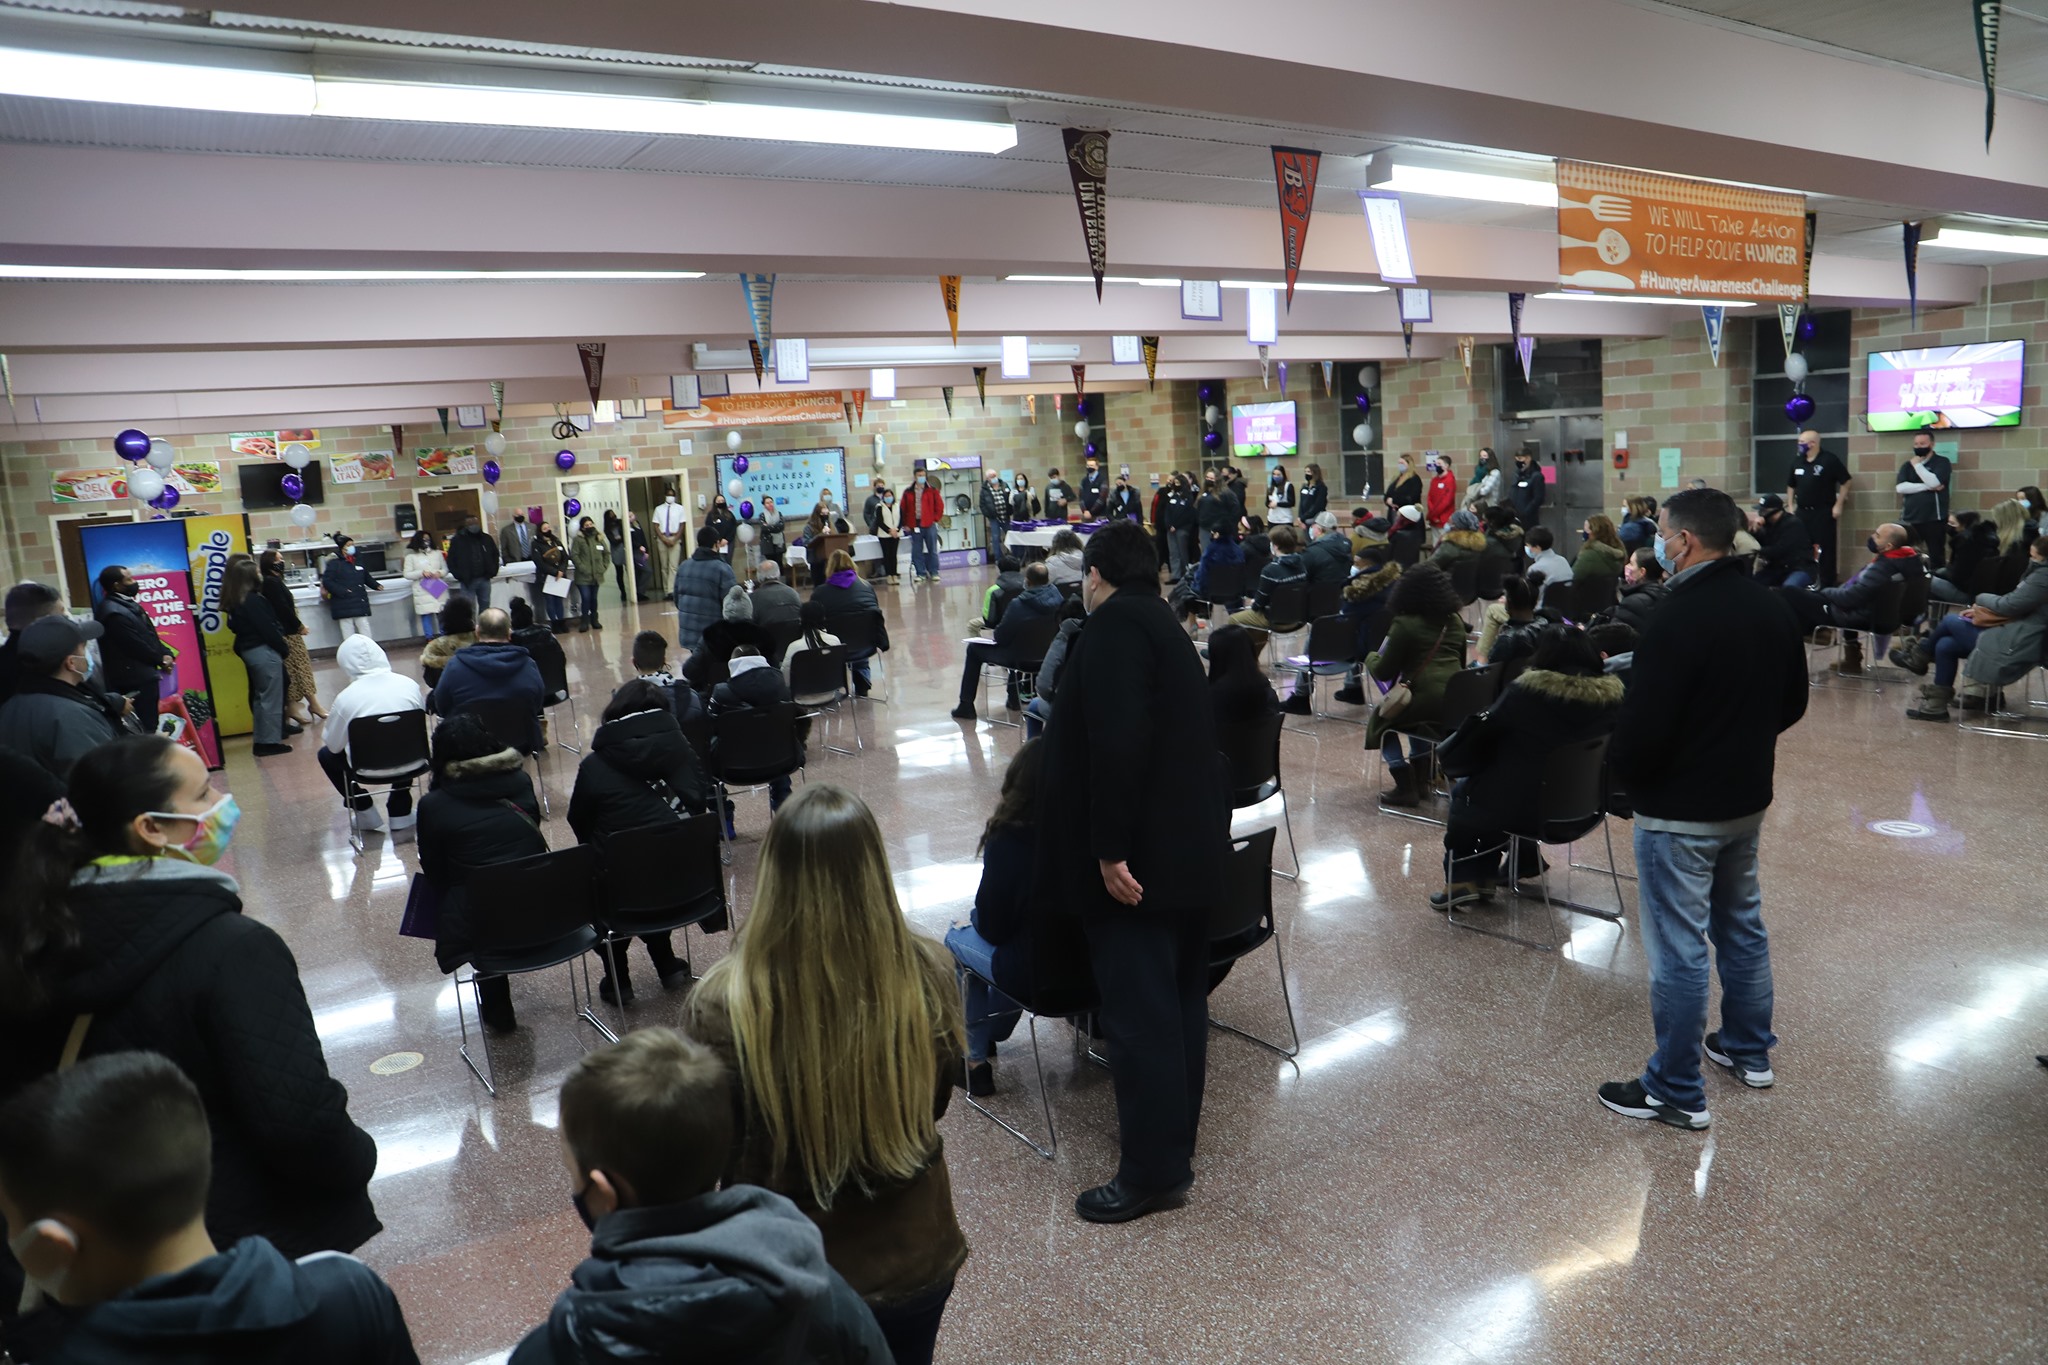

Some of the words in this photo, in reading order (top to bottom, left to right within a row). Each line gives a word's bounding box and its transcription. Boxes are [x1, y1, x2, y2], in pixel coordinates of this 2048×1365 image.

[1078, 181, 1099, 272] UNIVERSITY
[1649, 205, 1671, 227] WE
[1672, 208, 1705, 231] WILL
[1706, 214, 1745, 236] Take
[1749, 217, 1798, 241] Action
[1289, 226, 1297, 270] BUCKNELL
[1644, 232, 1666, 255] TO
[1669, 234, 1704, 258] HELP
[1705, 238, 1742, 262] SOLVE
[1745, 244, 1798, 265] HUNGER
[1639, 270, 1803, 298] #HungerAwarenessChallenge
[719, 401, 734, 412] TO
[736, 400, 760, 411] HELP
[763, 398, 795, 410] SOLVE
[795, 396, 837, 407] HUNGER
[718, 412, 841, 425] #HungerAwarenessChallenge
[336, 471, 362, 482] ITALY
[451, 464, 476, 474] PLATE
[750, 471, 811, 482] WELLNESS
[748, 480, 816, 493] WEDNESDAY
[136, 577, 168, 590] ERO
[199, 531, 230, 633] Snapple
[132, 589, 179, 604] UGAR.
[152, 601, 185, 614] THE
